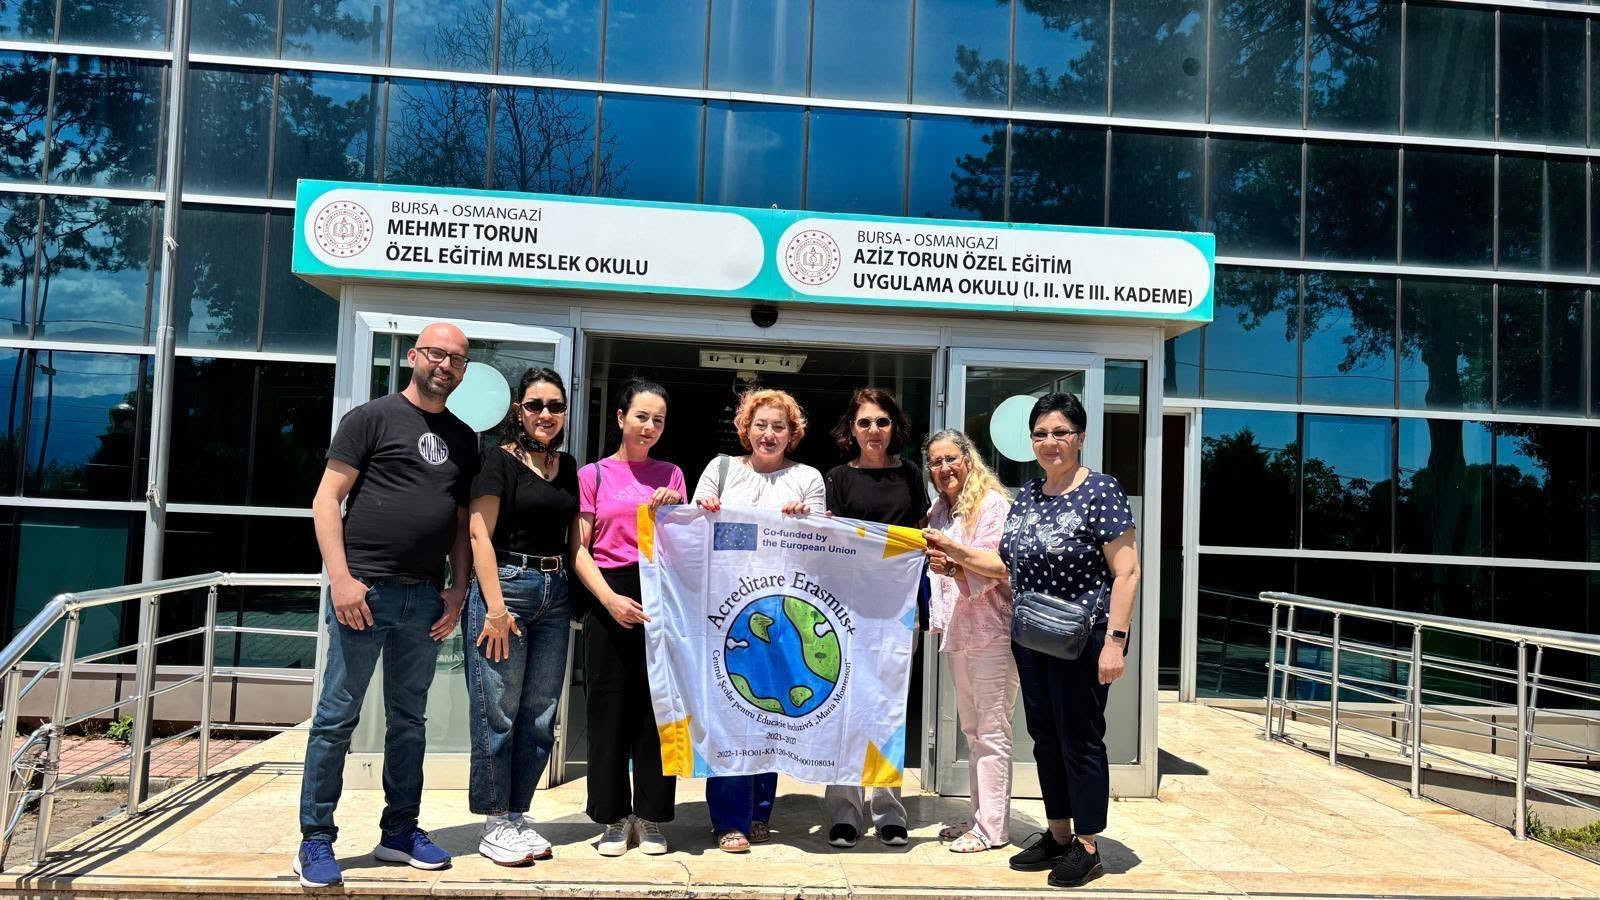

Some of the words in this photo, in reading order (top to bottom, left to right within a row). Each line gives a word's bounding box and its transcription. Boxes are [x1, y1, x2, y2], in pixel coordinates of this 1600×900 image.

[391, 201, 439, 216] BURSA
[452, 204, 542, 222] OSMANGAZİ
[387, 218, 470, 239] MEHMET
[473, 223, 538, 244] TORUN
[857, 230, 902, 245] BURSA
[914, 233, 998, 250] OSMANGAZİ
[385, 241, 433, 263] ÖZEL
[438, 245, 502, 267] EĞİTİM
[508, 251, 581, 272] MESLEK
[585, 256, 648, 276] OKULU
[853, 248, 894, 266] AZİZ
[897, 251, 958, 270] TORUN
[962, 251, 1007, 272] ÖZEL
[1012, 253, 1072, 275] EĞİTİM
[853, 272, 954, 294] UYGULAMA
[958, 278, 1019, 297] OKULU
[1023, 281, 1039, 300] (I.
[1043, 283, 1059, 299] II.
[1063, 283, 1084, 300] VE
[1088, 284, 1110, 301] III.
[1114, 286, 1193, 307] KADEME)
[762, 539, 777, 548] the
[780, 540, 826, 552] European
[828, 545, 857, 555] Union
[763, 528, 813, 540] Co-funded
[815, 532, 828, 543] by
[707, 574, 785, 630] Acreditare
[790, 571, 857, 636] Erasmus+
[712, 649, 725, 680] Centrul
[731, 701, 755, 719] pentru
